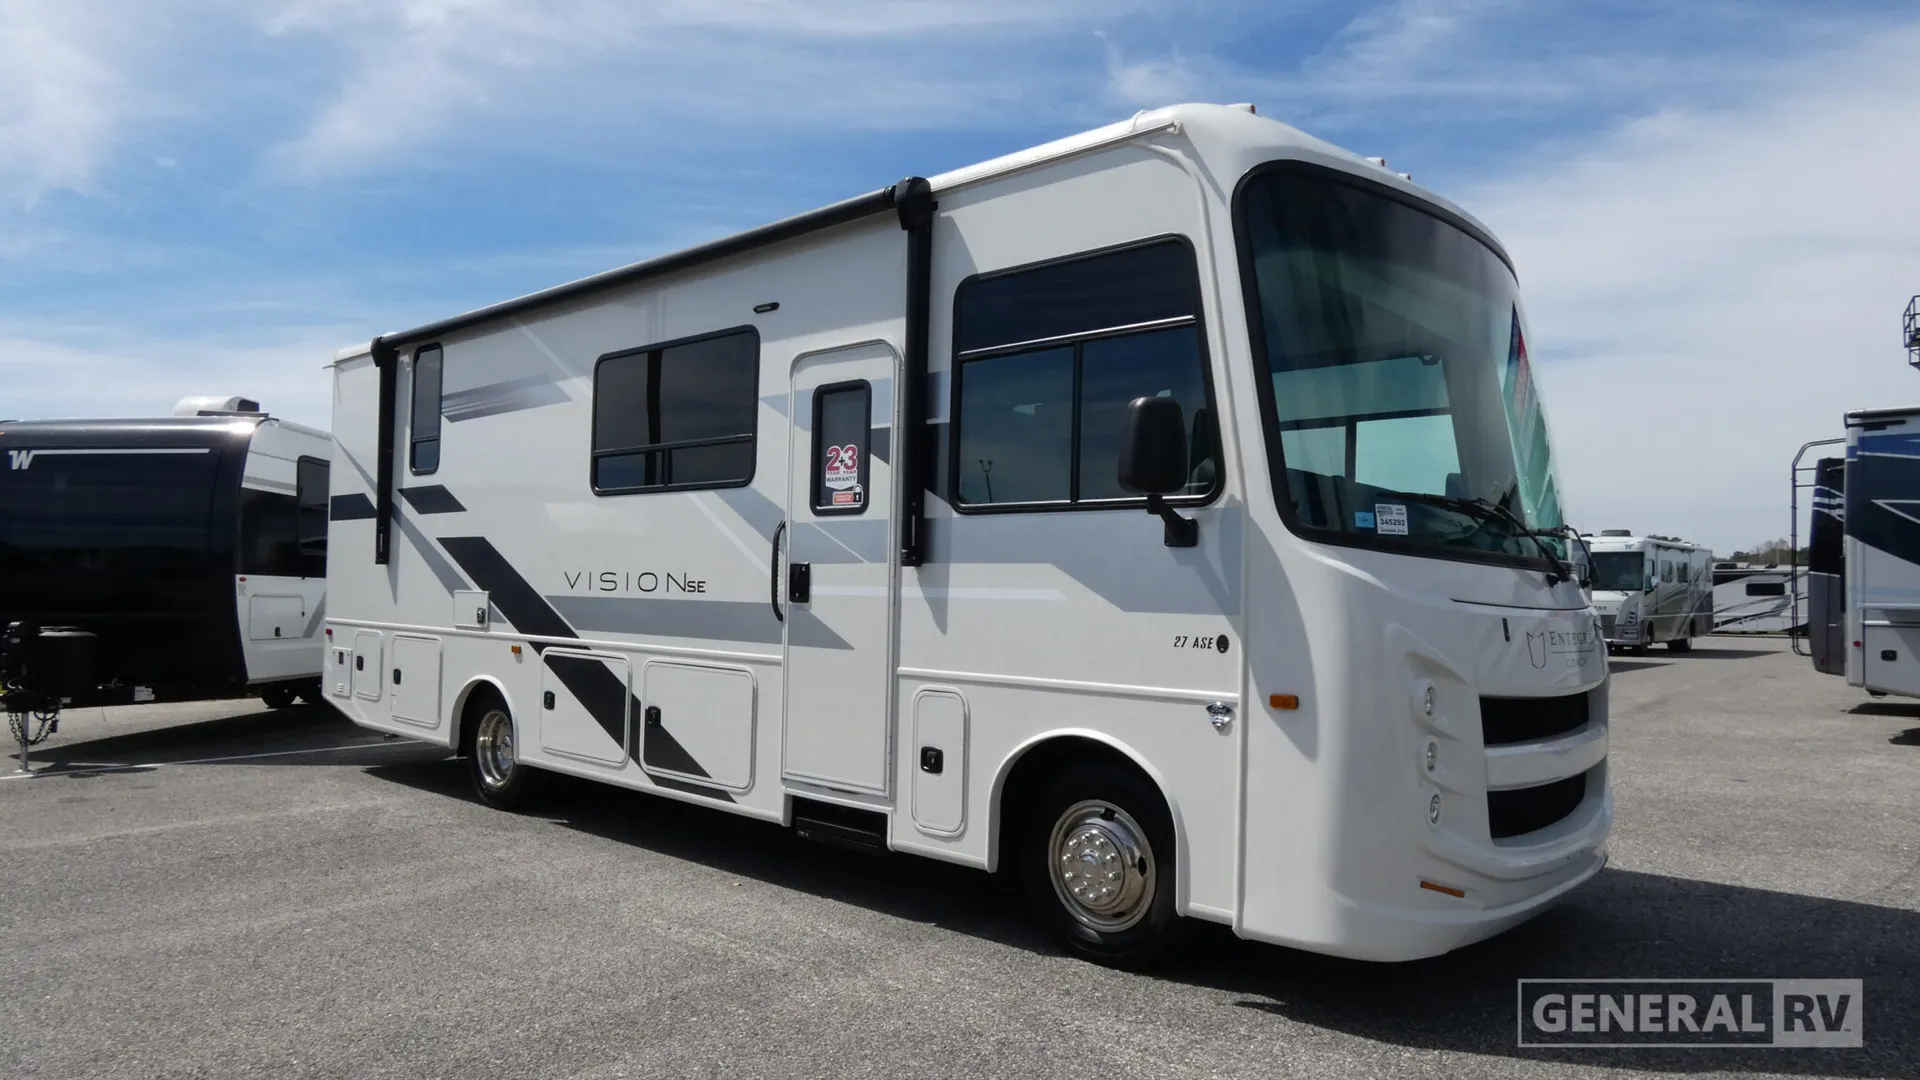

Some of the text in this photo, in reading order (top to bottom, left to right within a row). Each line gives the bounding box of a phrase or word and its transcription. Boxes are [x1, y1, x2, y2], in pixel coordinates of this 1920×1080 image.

[1380, 518, 1405, 526] 345292
[1174, 636, 1213, 649] 27 ASE
